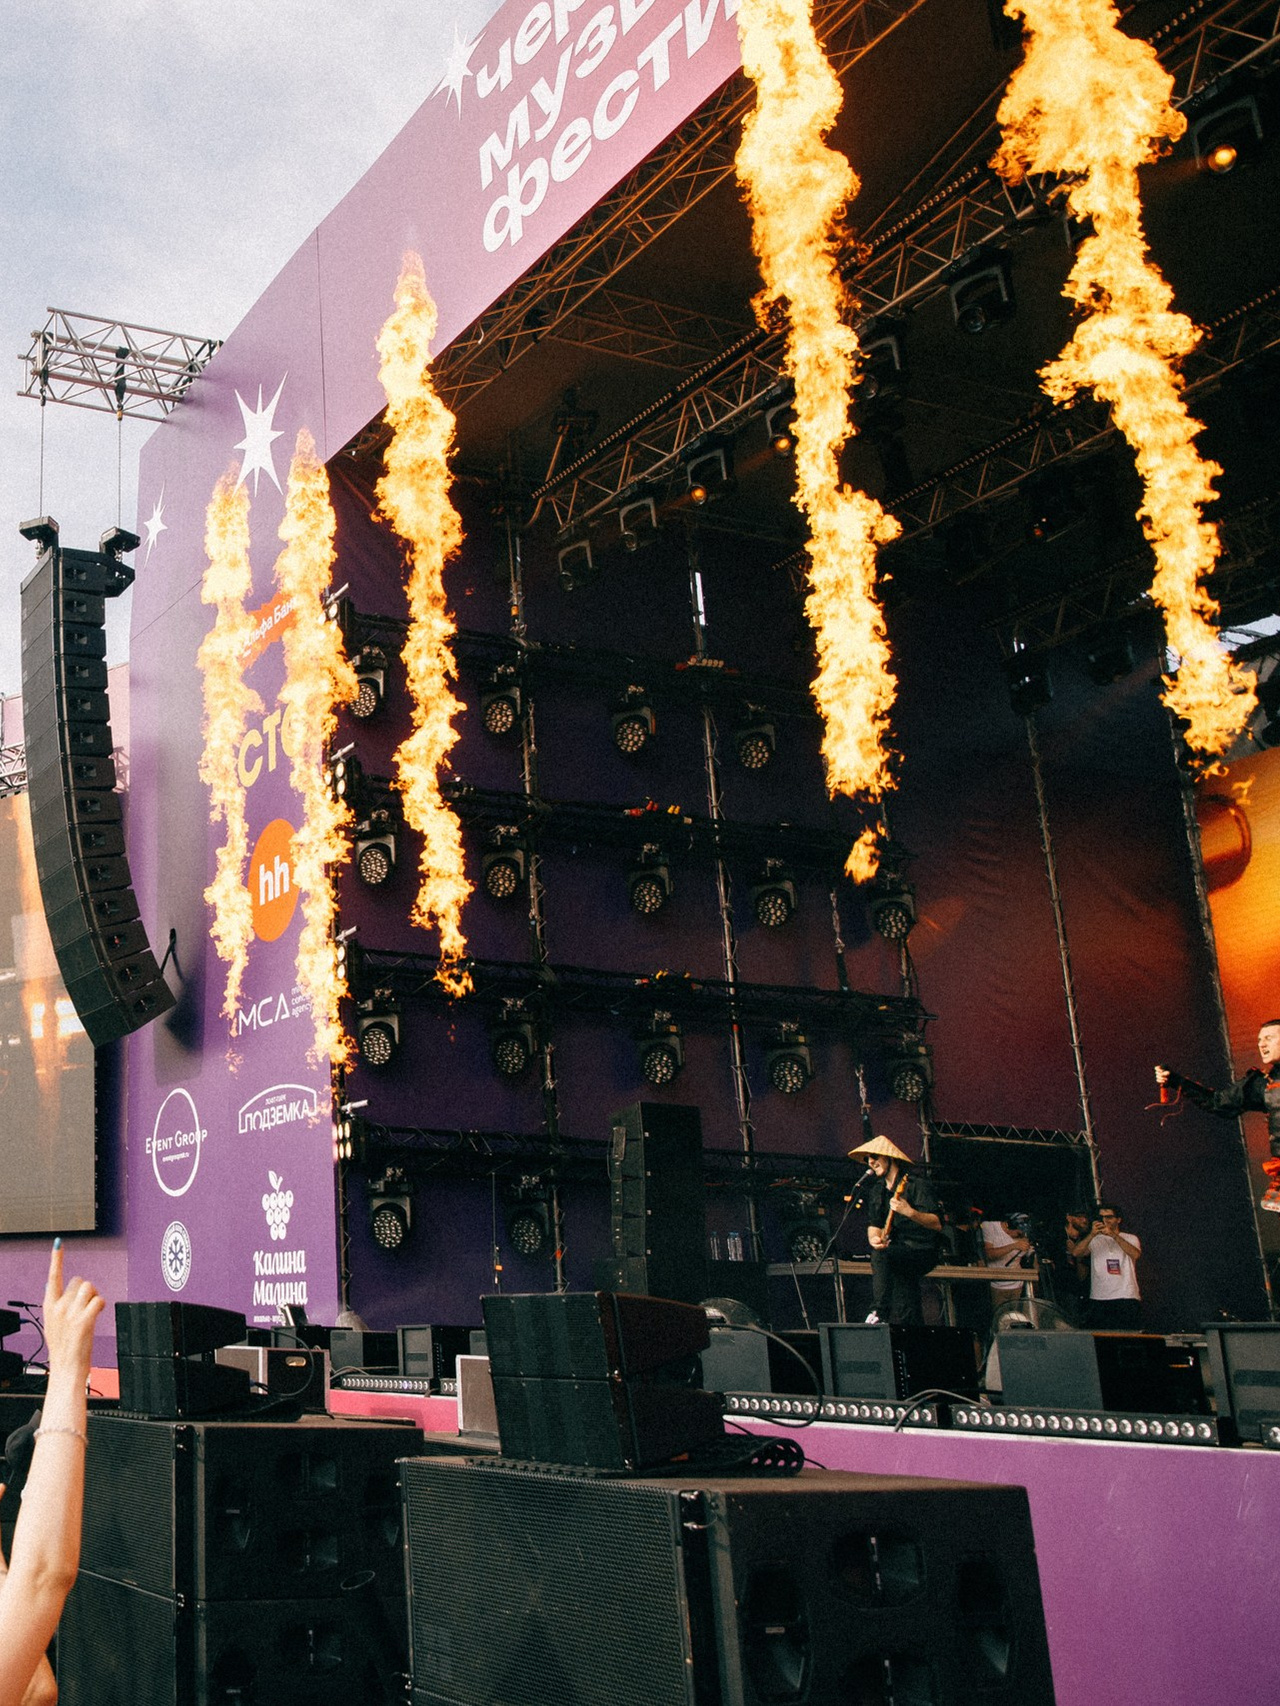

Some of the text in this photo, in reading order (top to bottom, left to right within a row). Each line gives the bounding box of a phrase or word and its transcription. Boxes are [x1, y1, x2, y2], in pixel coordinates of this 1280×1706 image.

[259, 855, 290, 906] hh
[244, 1099, 309, 1132] ПОДЗЕМКА
[252, 1250, 307, 1276] Калина
[252, 1280, 308, 1307] Малина
